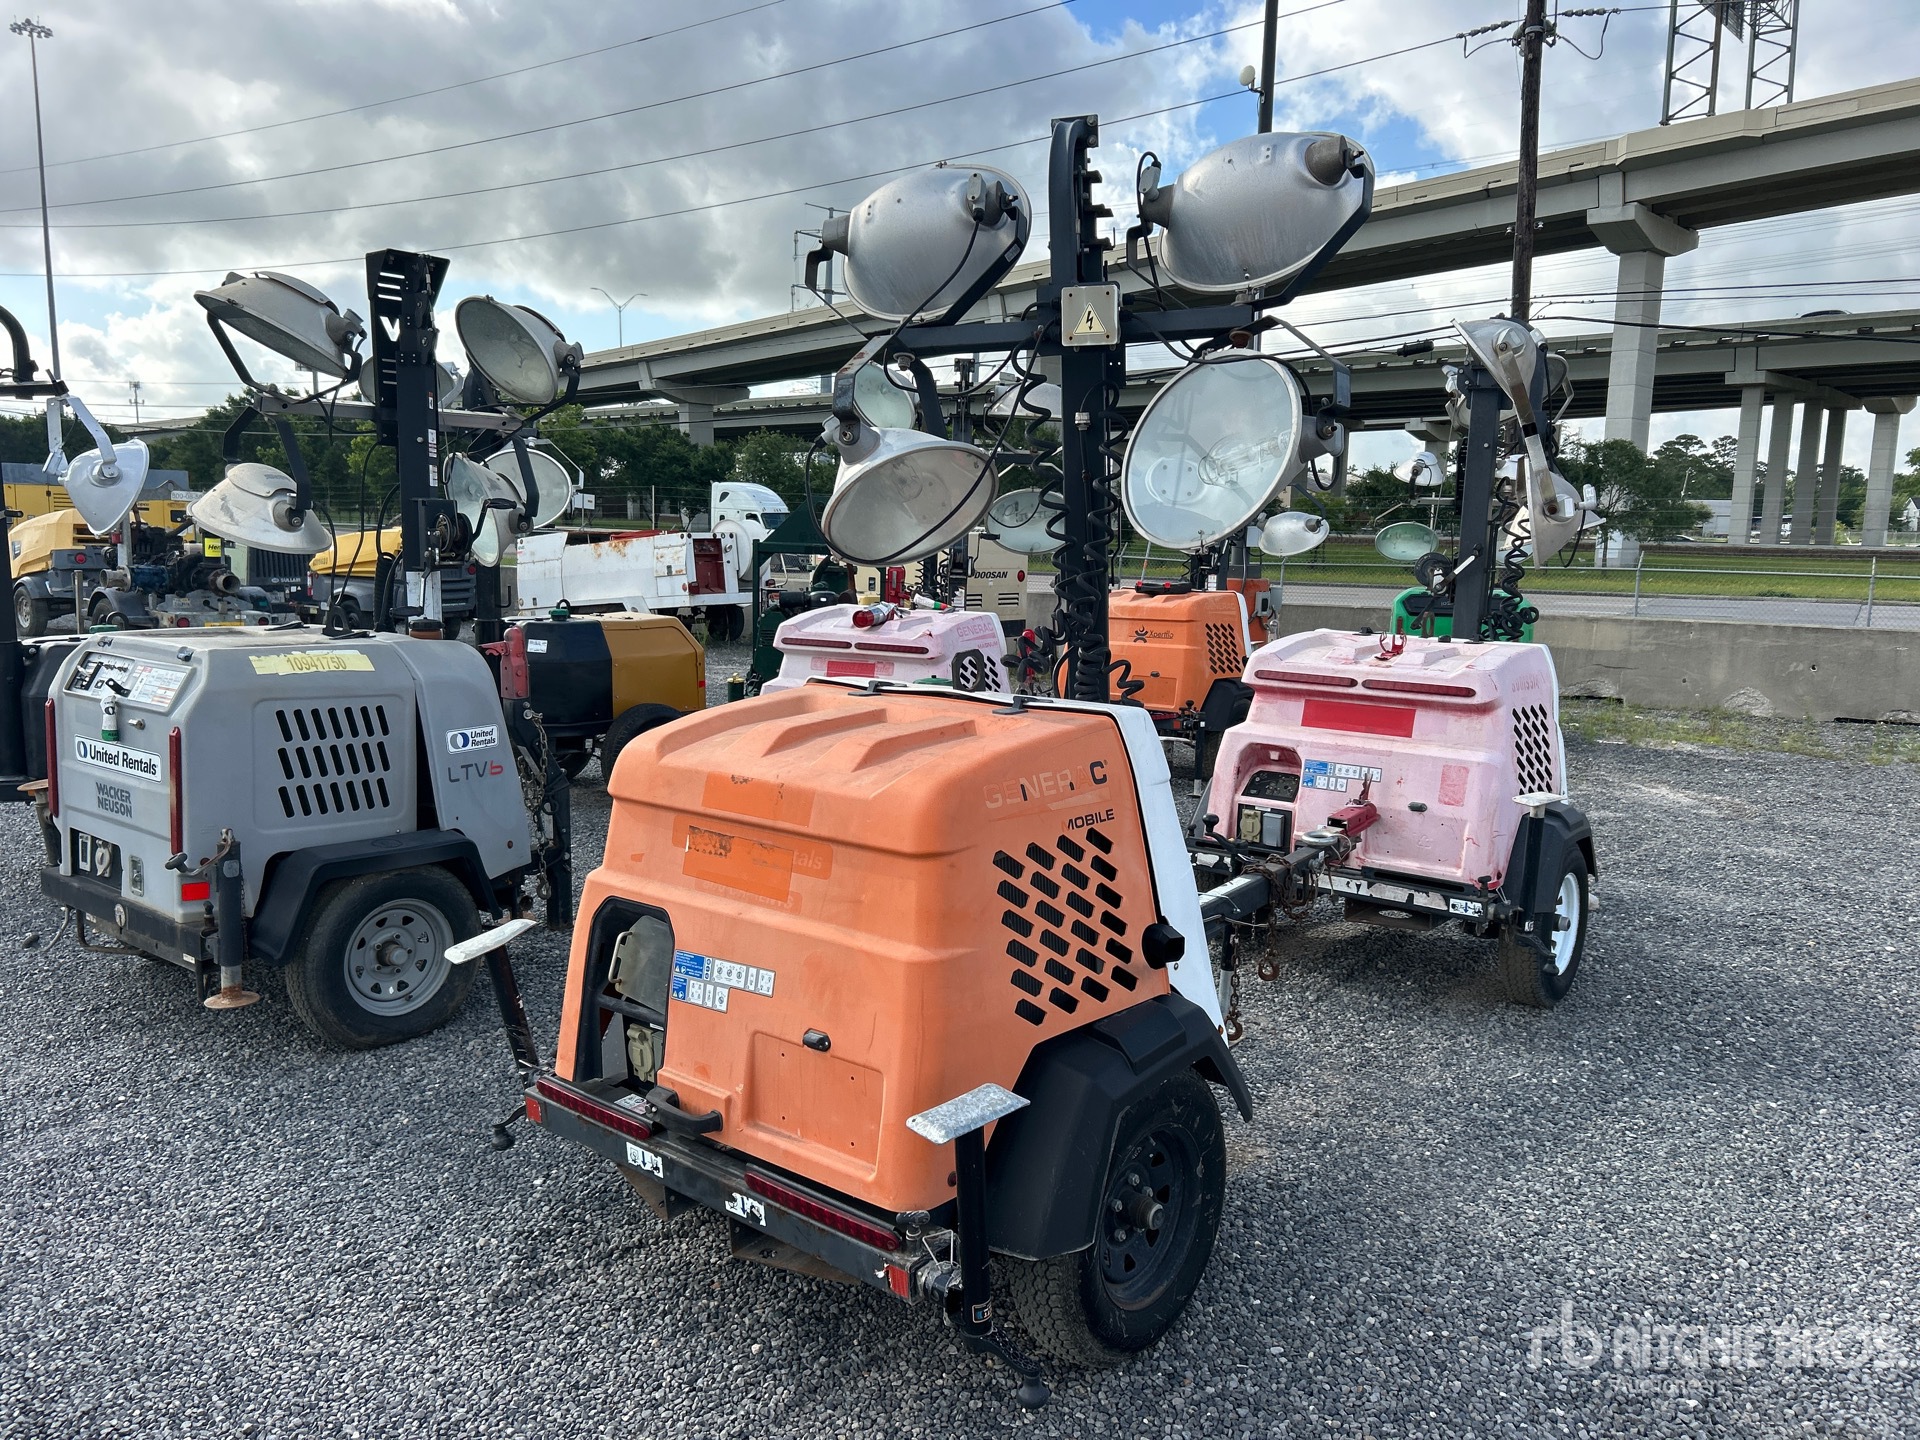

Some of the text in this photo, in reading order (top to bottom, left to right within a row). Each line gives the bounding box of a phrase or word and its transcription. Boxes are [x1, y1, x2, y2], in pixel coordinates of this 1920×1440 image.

[974, 571, 1008, 579] DOOSAN
[956, 622, 994, 637] GENERAC
[977, 641, 999, 650] MAGNUM
[286, 656, 347, 672] 10941750
[471, 728, 494, 739] United
[471, 737, 496, 747] Rentals
[89, 744, 157, 776] United Rentals
[983, 760, 1108, 809] GENERAC
[96, 782, 132, 804] WACKER
[97, 796, 133, 818] NEUSON
[1064, 808, 1115, 831] MOBILE
